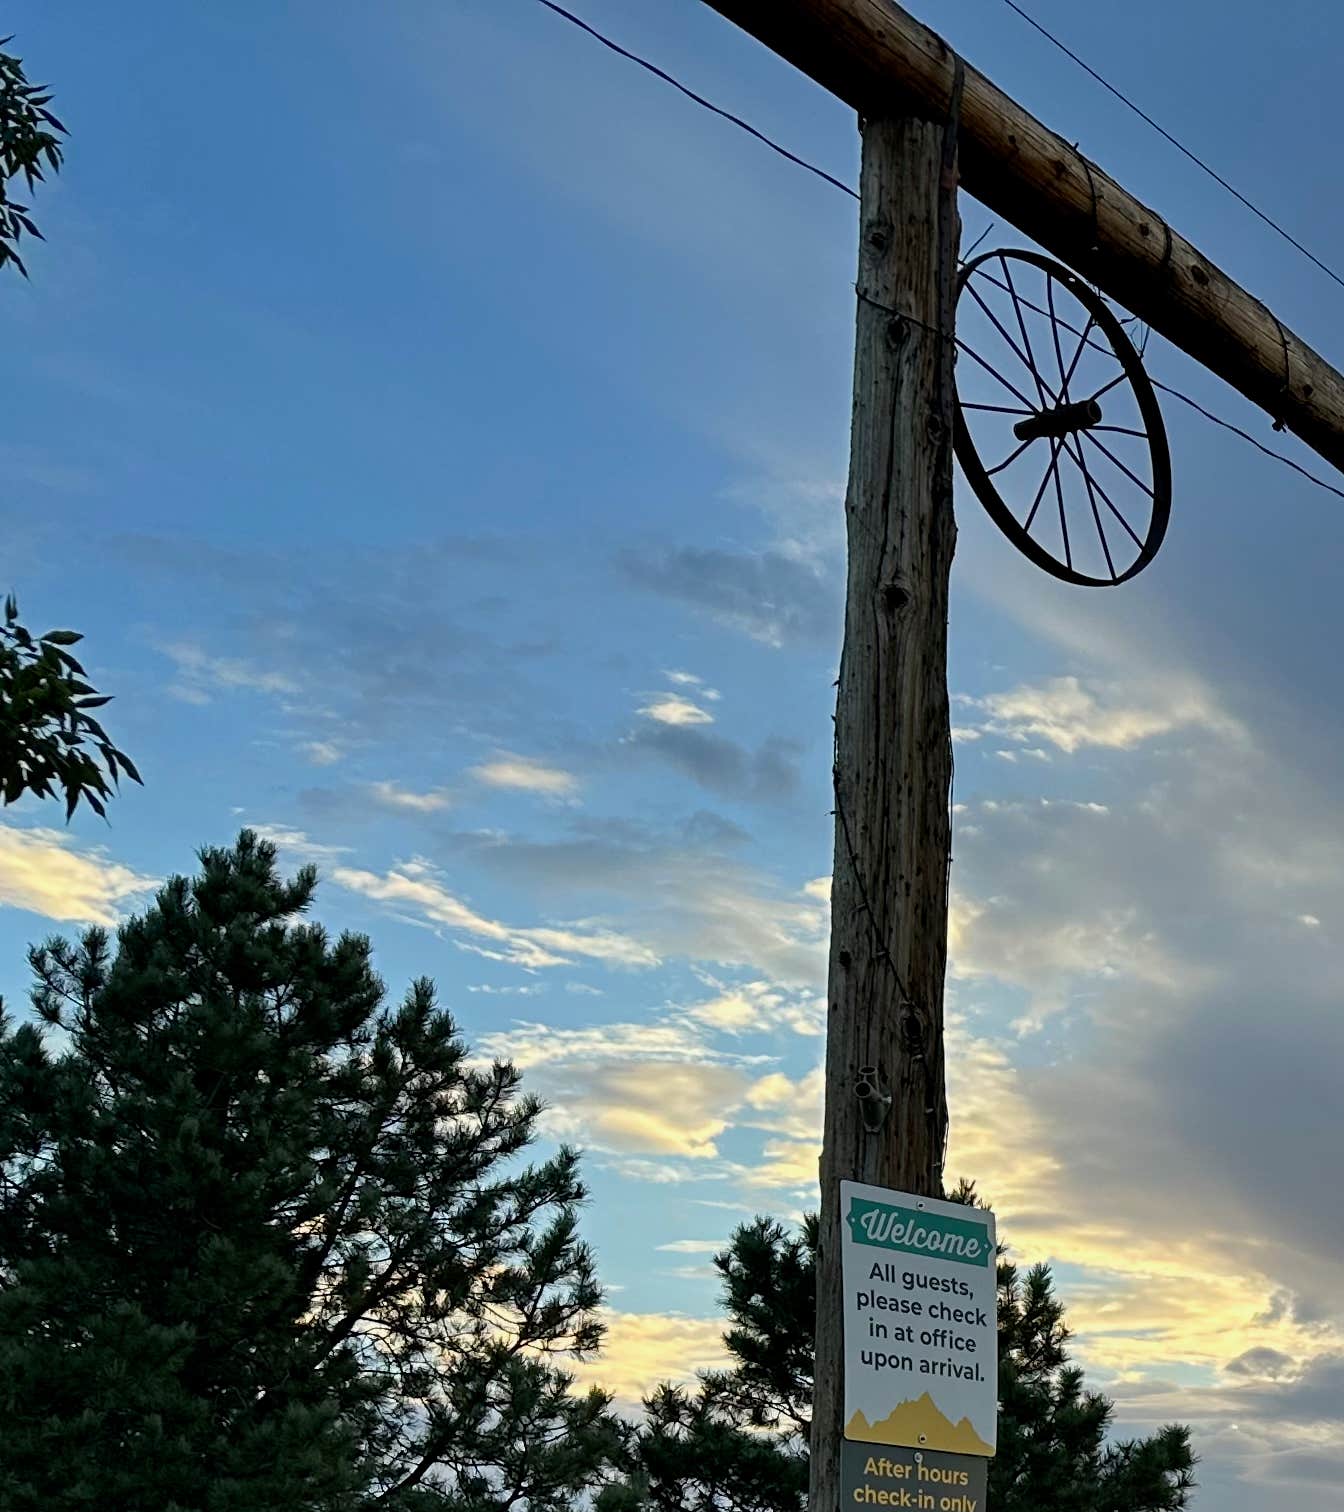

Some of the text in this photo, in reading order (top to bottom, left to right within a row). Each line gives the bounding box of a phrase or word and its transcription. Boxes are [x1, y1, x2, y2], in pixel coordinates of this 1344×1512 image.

[860, 1208, 981, 1258] Welcome
[869, 1262, 974, 1300] All guests,
[857, 1290, 987, 1327] please check
[869, 1317, 976, 1352] in at office
[861, 1350, 985, 1382] upon arrival.
[863, 1457, 969, 1485] After hours
[853, 1484, 935, 1509] check-in
